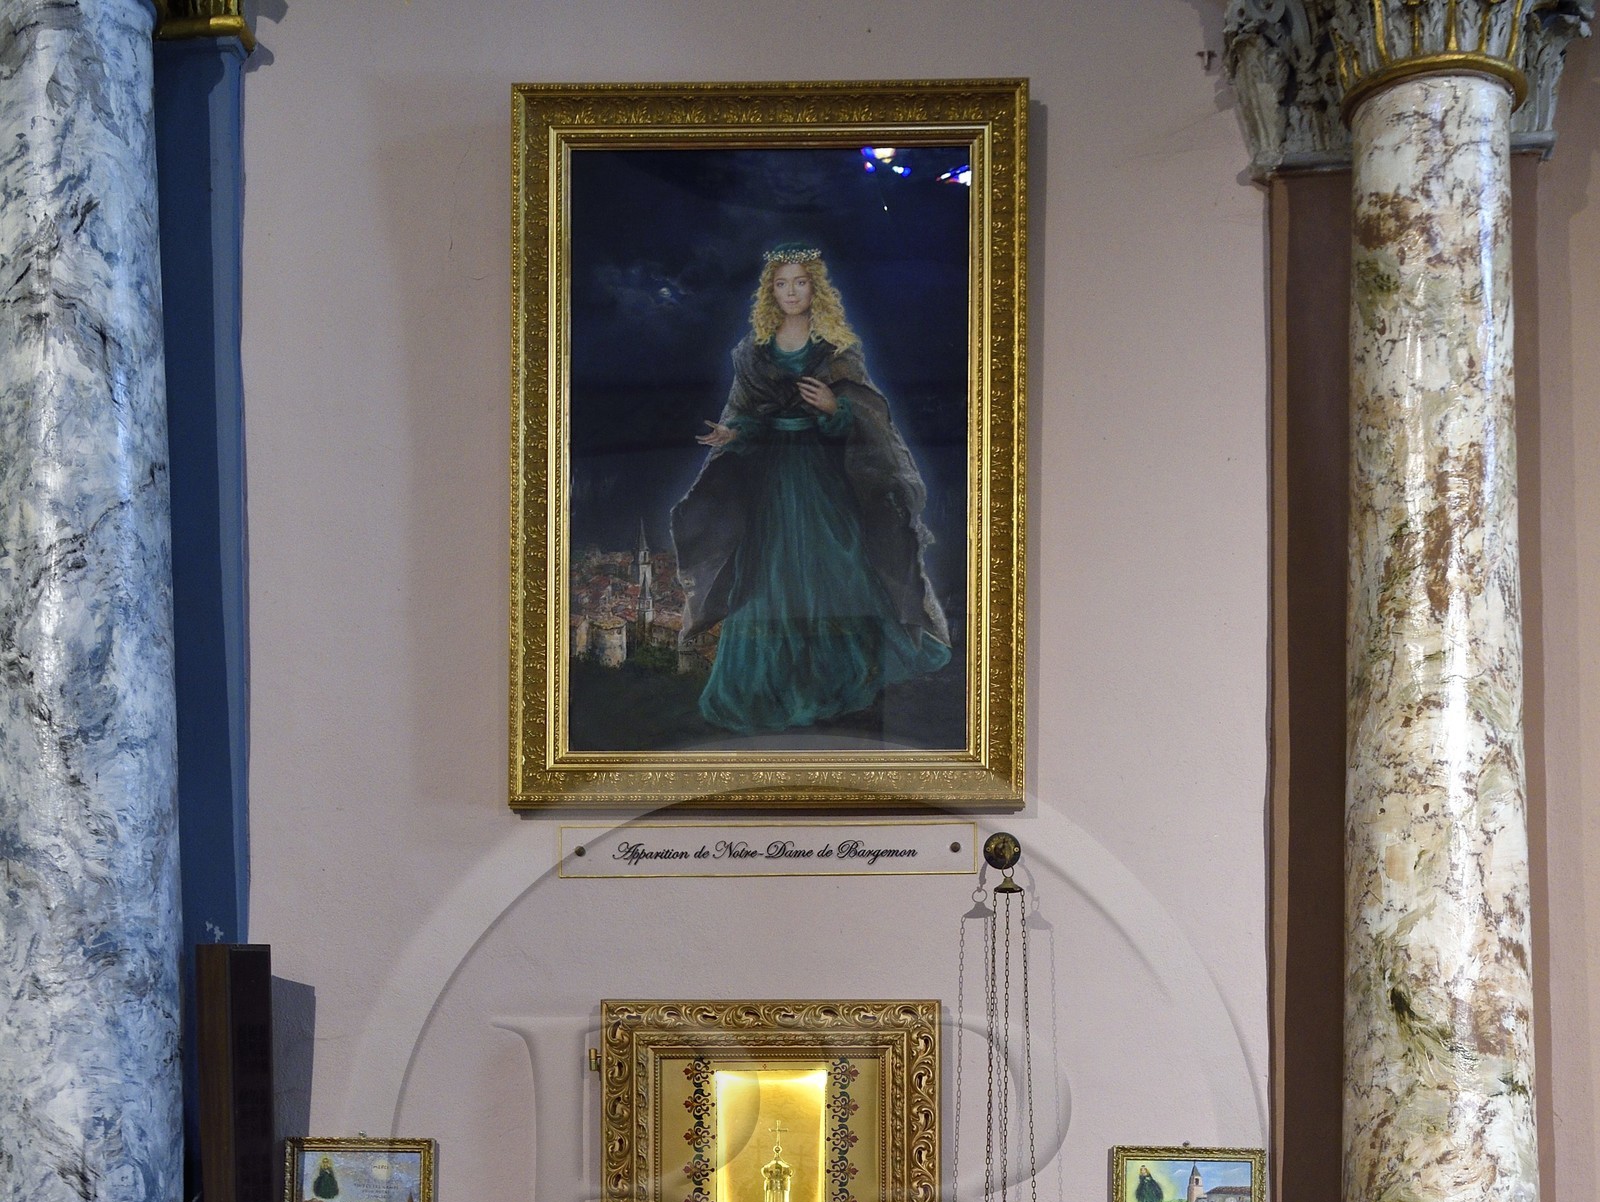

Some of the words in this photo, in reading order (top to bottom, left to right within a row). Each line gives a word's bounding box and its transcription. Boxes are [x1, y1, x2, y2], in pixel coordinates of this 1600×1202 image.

[612, 841, 688, 865] Apparition
[694, 844, 709, 859] de
[712, 840, 814, 859] Notre-Dame
[816, 843, 833, 858] de
[836, 839, 918, 865] Bargemon
